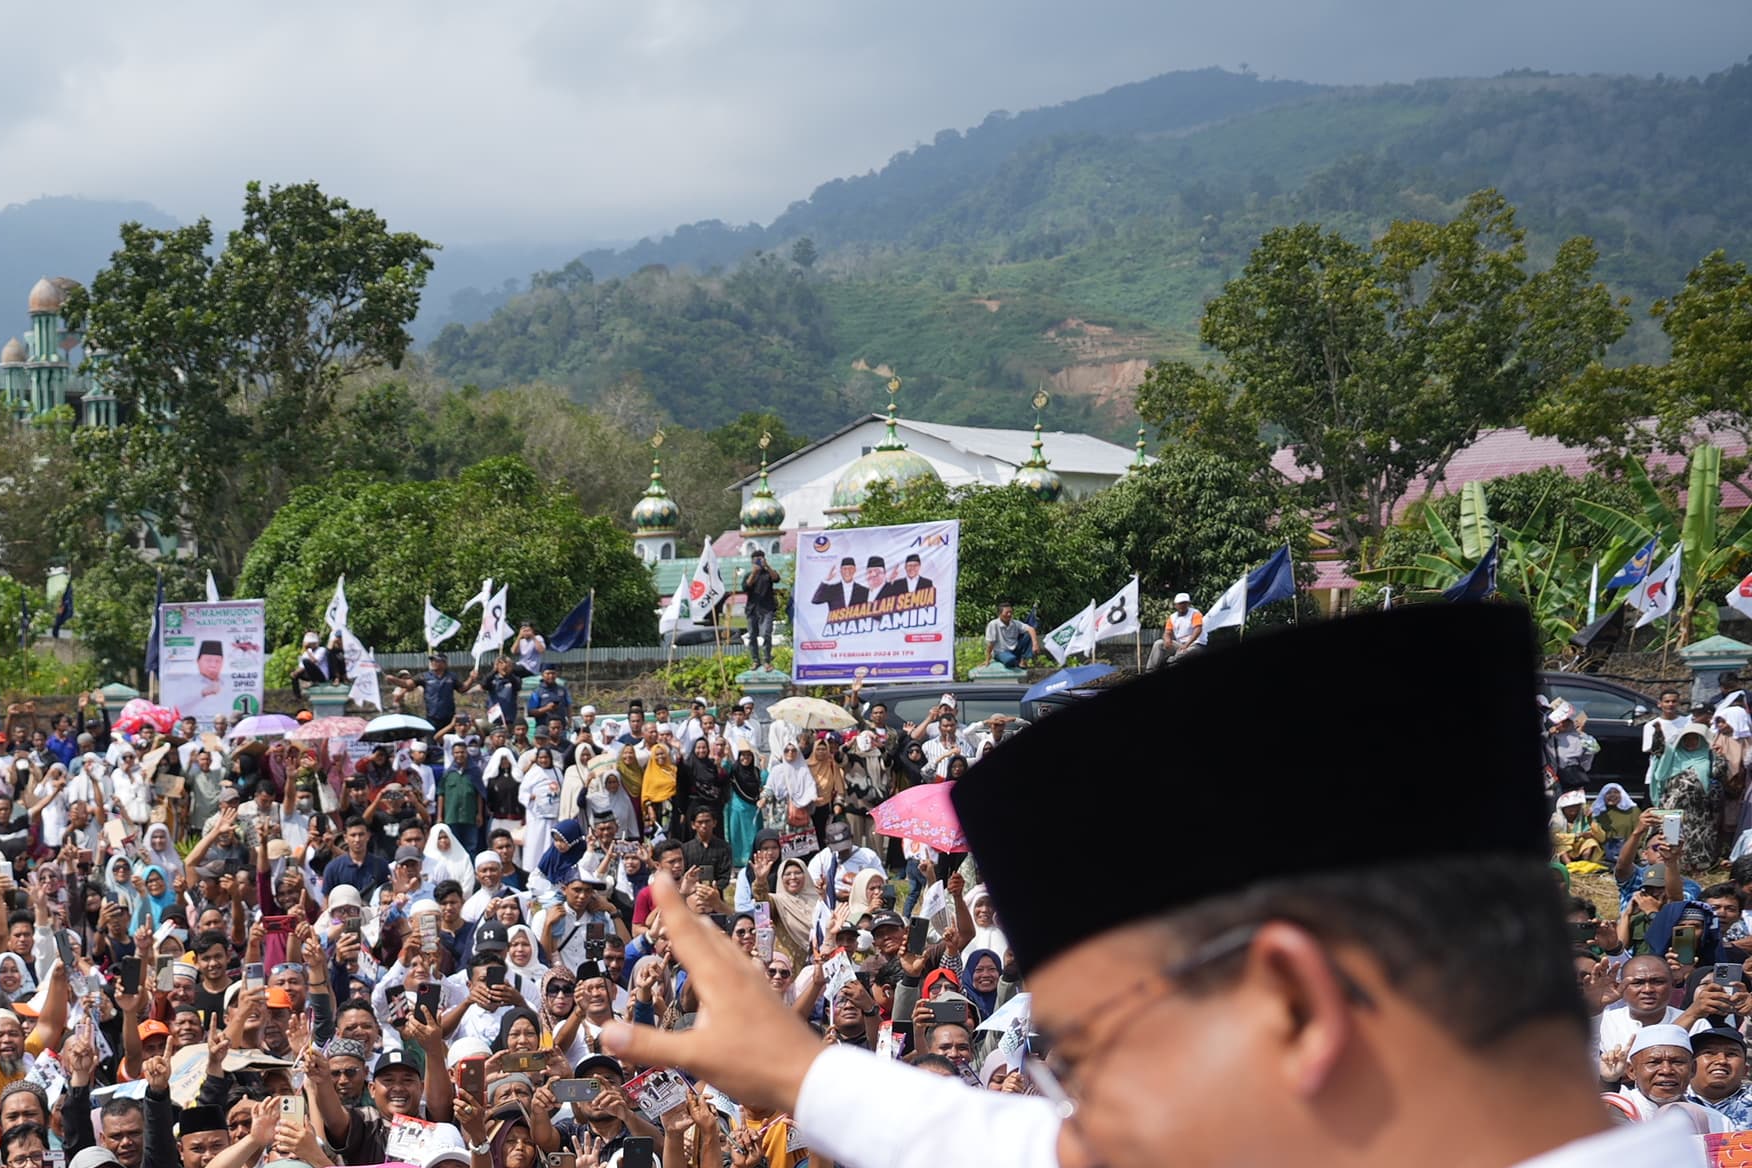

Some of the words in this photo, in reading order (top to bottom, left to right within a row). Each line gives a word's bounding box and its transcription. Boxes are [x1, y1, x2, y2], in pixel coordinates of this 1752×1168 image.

[828, 600, 895, 621] INSHAALLAH
[898, 587, 934, 609] SEMUA
[822, 617, 873, 637] AMAN
[880, 607, 937, 630] AMIN
